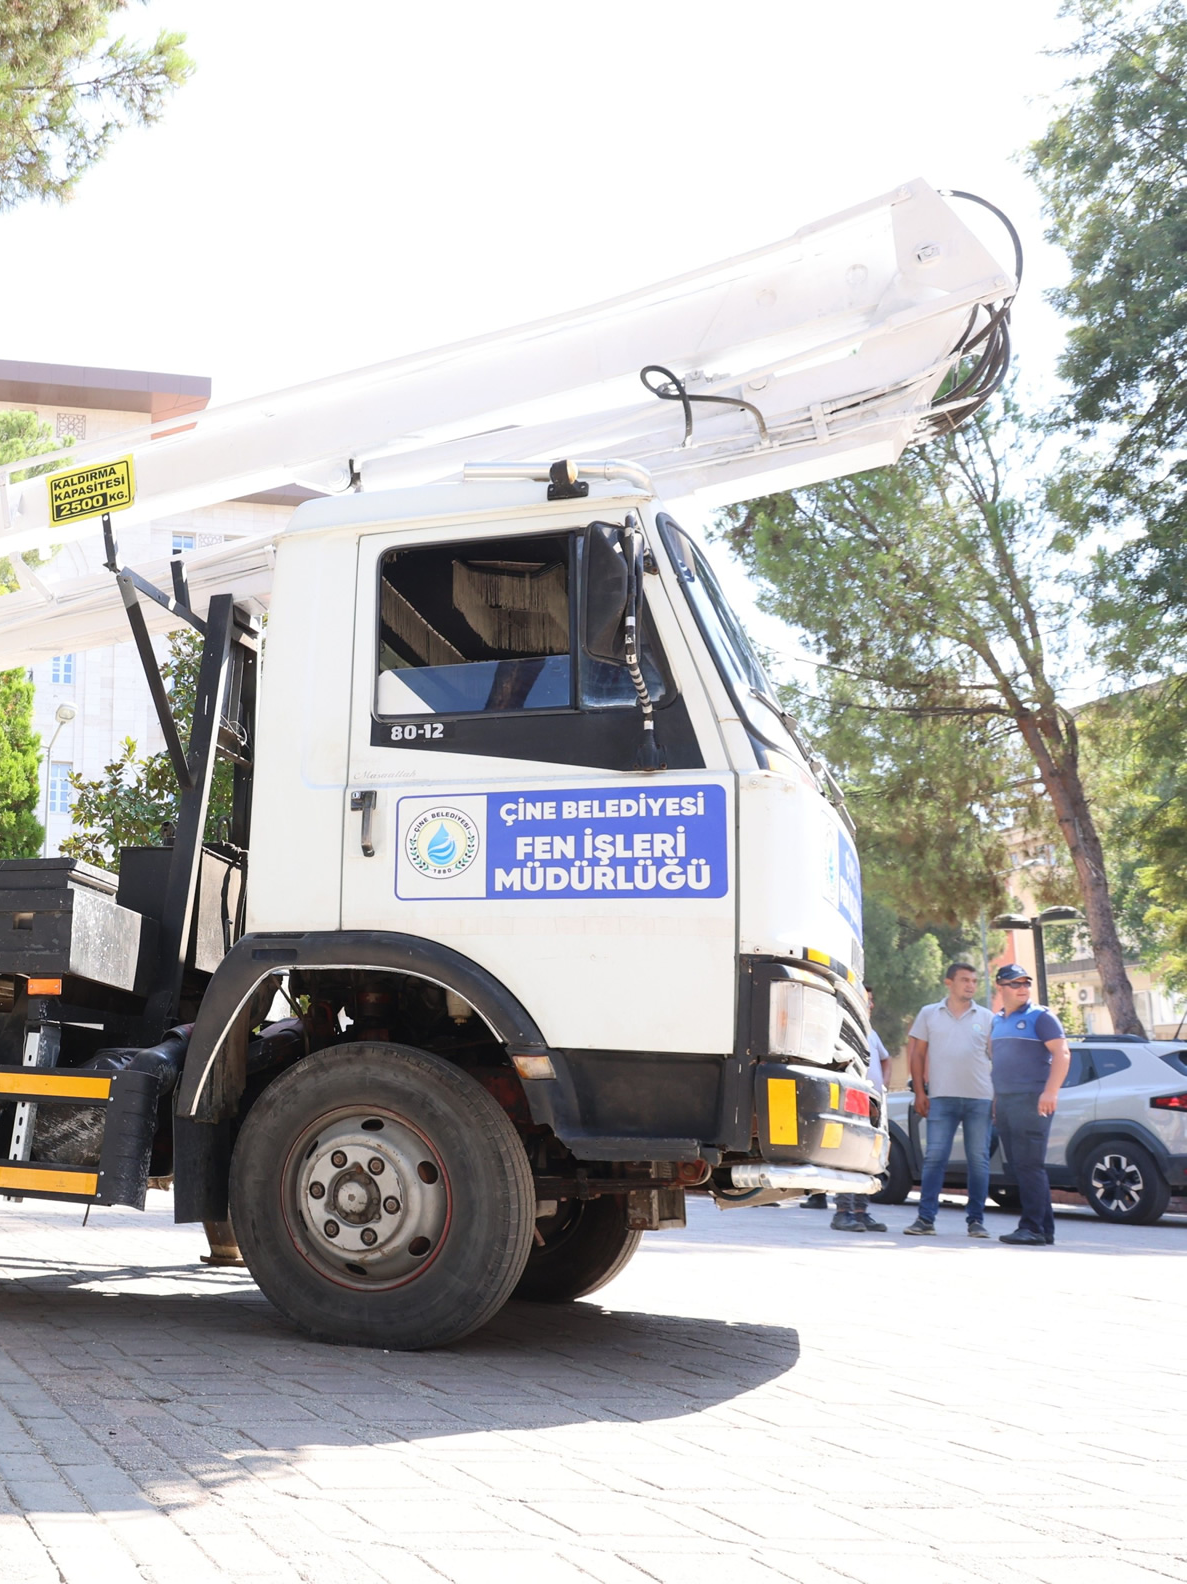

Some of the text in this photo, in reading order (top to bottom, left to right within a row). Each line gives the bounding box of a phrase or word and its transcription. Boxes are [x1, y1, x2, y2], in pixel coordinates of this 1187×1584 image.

[54, 467, 116, 491] KALDIRMA
[55, 474, 125, 502] KAPASİTESİ
[60, 491, 127, 516] 2500 KG.
[390, 723, 444, 741] 80-12
[499, 791, 705, 826] ÇİNE BELEDİYESİ
[515, 825, 686, 865] FEN İŞLERİ
[494, 857, 711, 892] MÜDÜRLÜĞÜ
